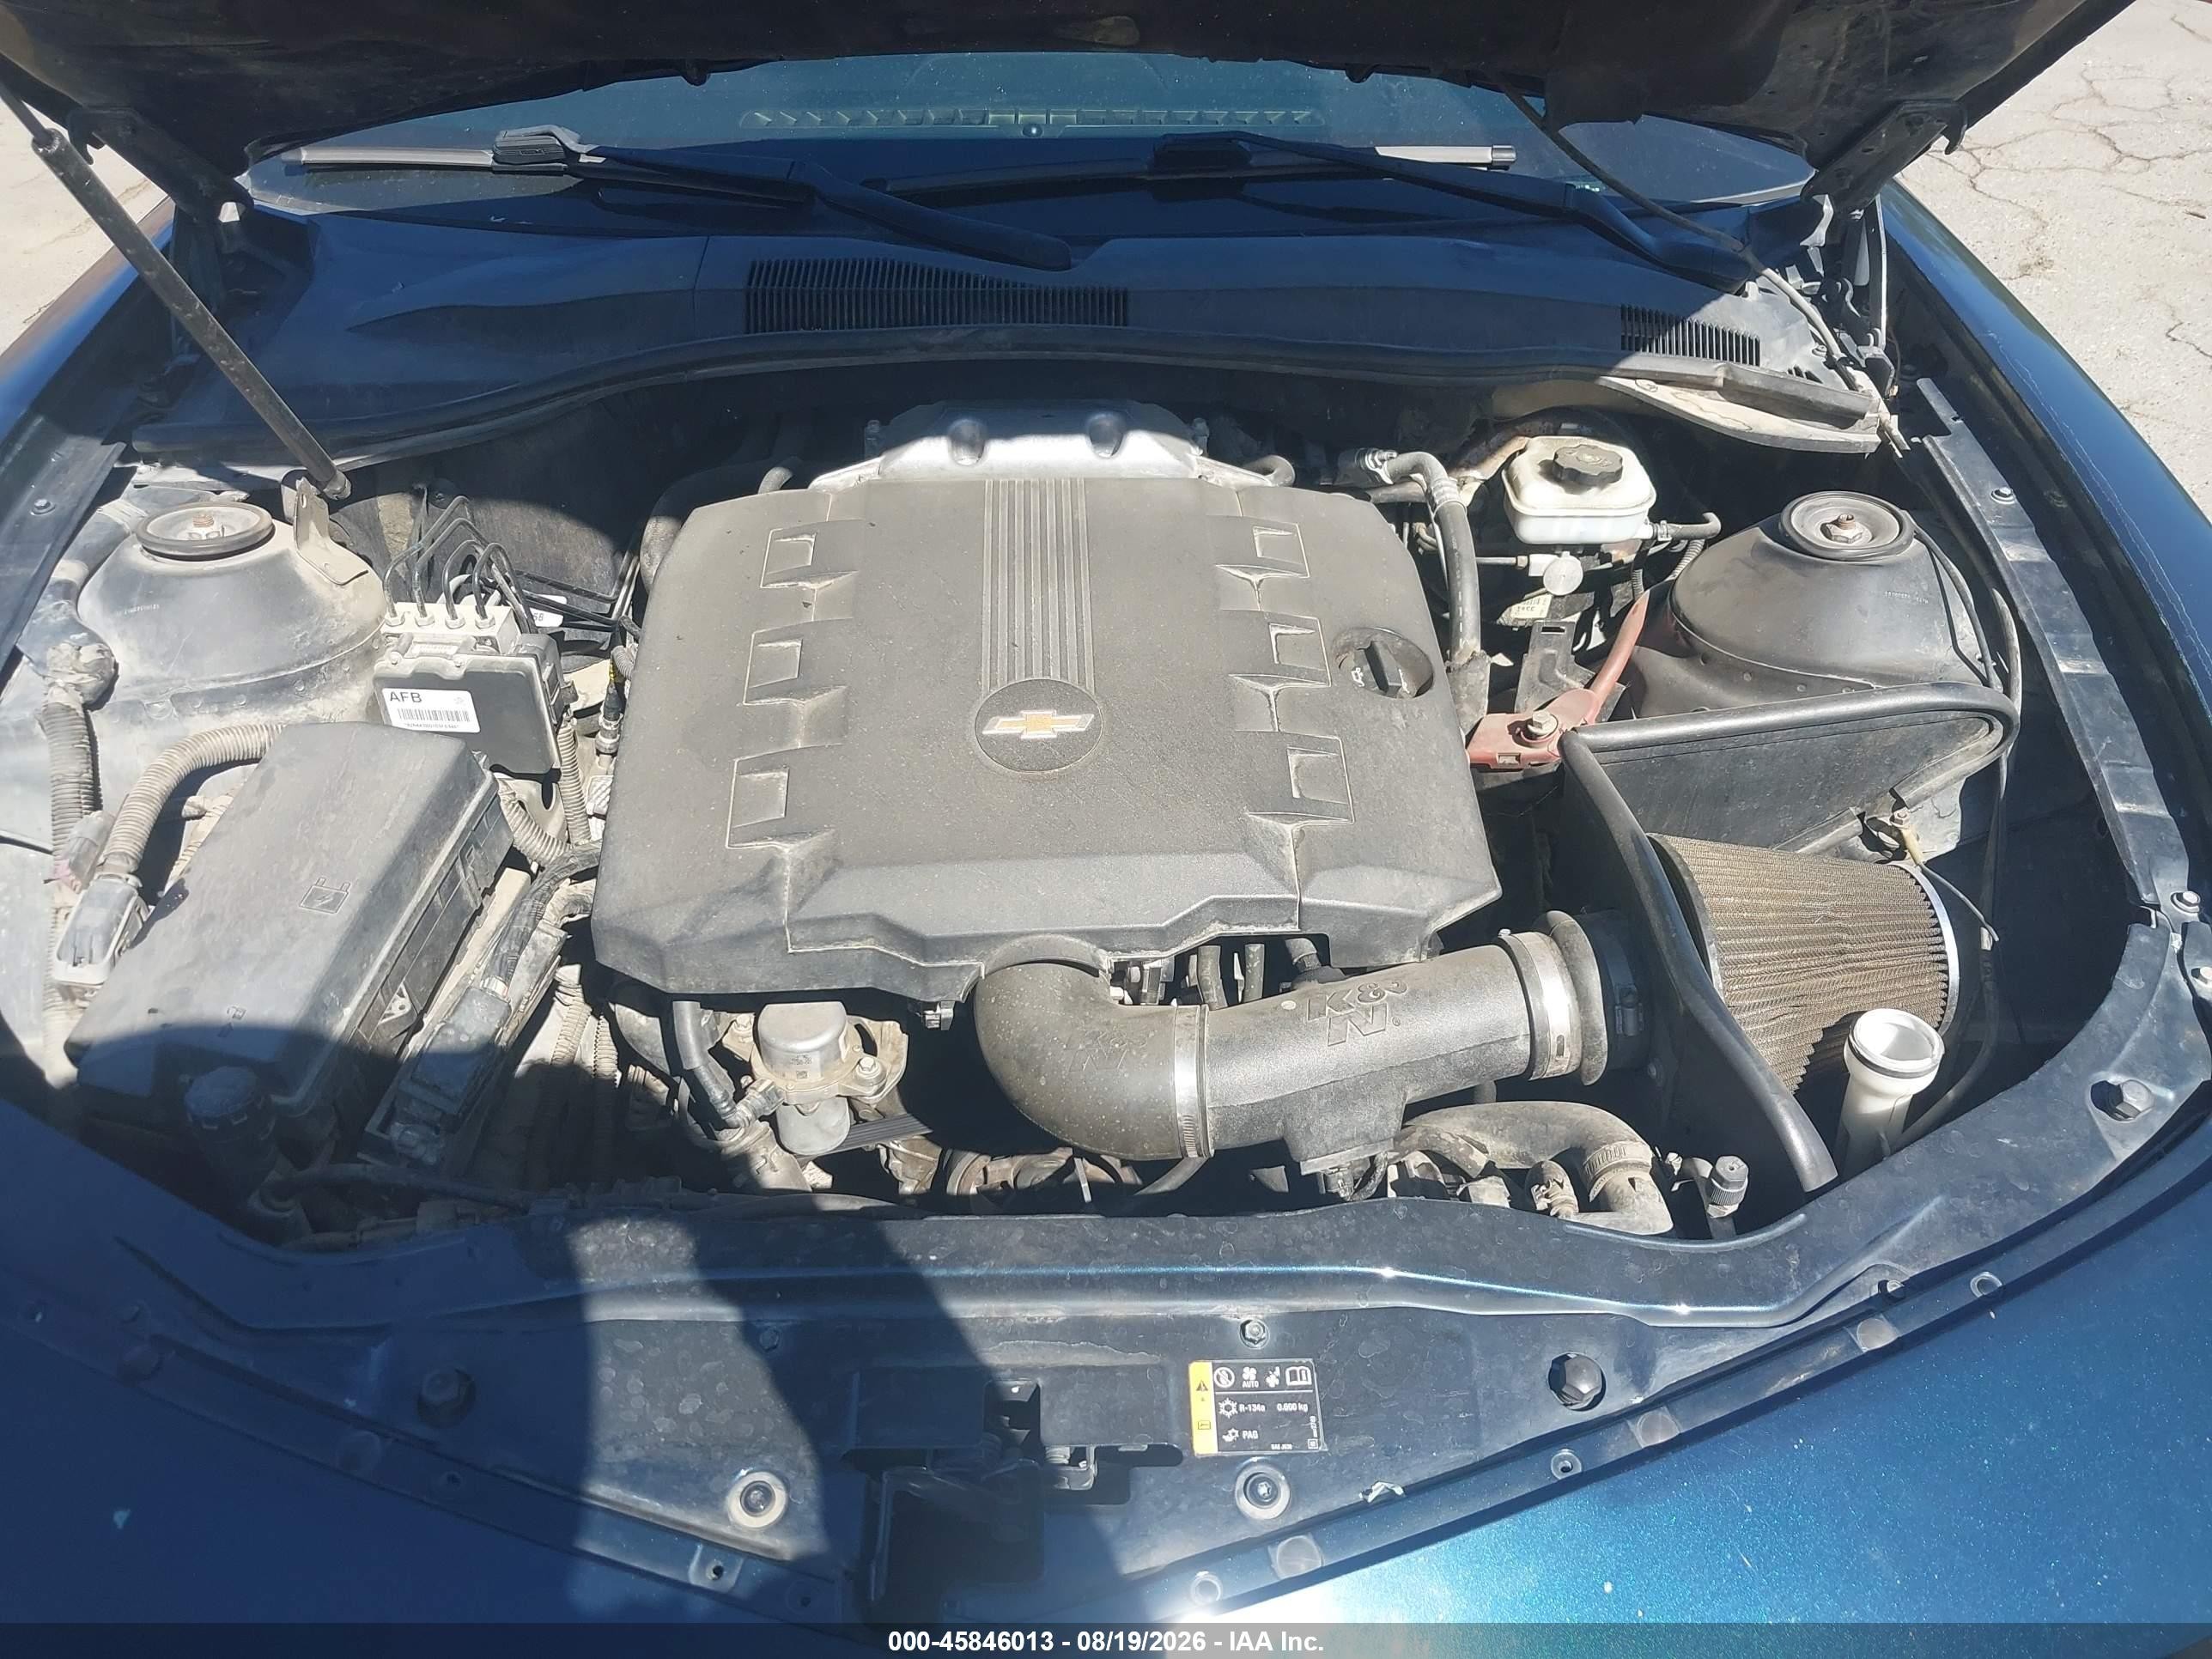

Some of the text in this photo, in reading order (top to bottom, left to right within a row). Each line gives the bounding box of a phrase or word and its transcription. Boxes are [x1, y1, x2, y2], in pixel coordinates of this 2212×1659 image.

[390, 691, 422, 703] AFB
[1306, 981, 1409, 1048] K&N
[1242, 1380, 1260, 1389] AUTO
[1239, 1404, 1266, 1413] R-134a
[1297, 1402, 1309, 1413] kg
[1242, 1430, 1259, 1439] PAG
